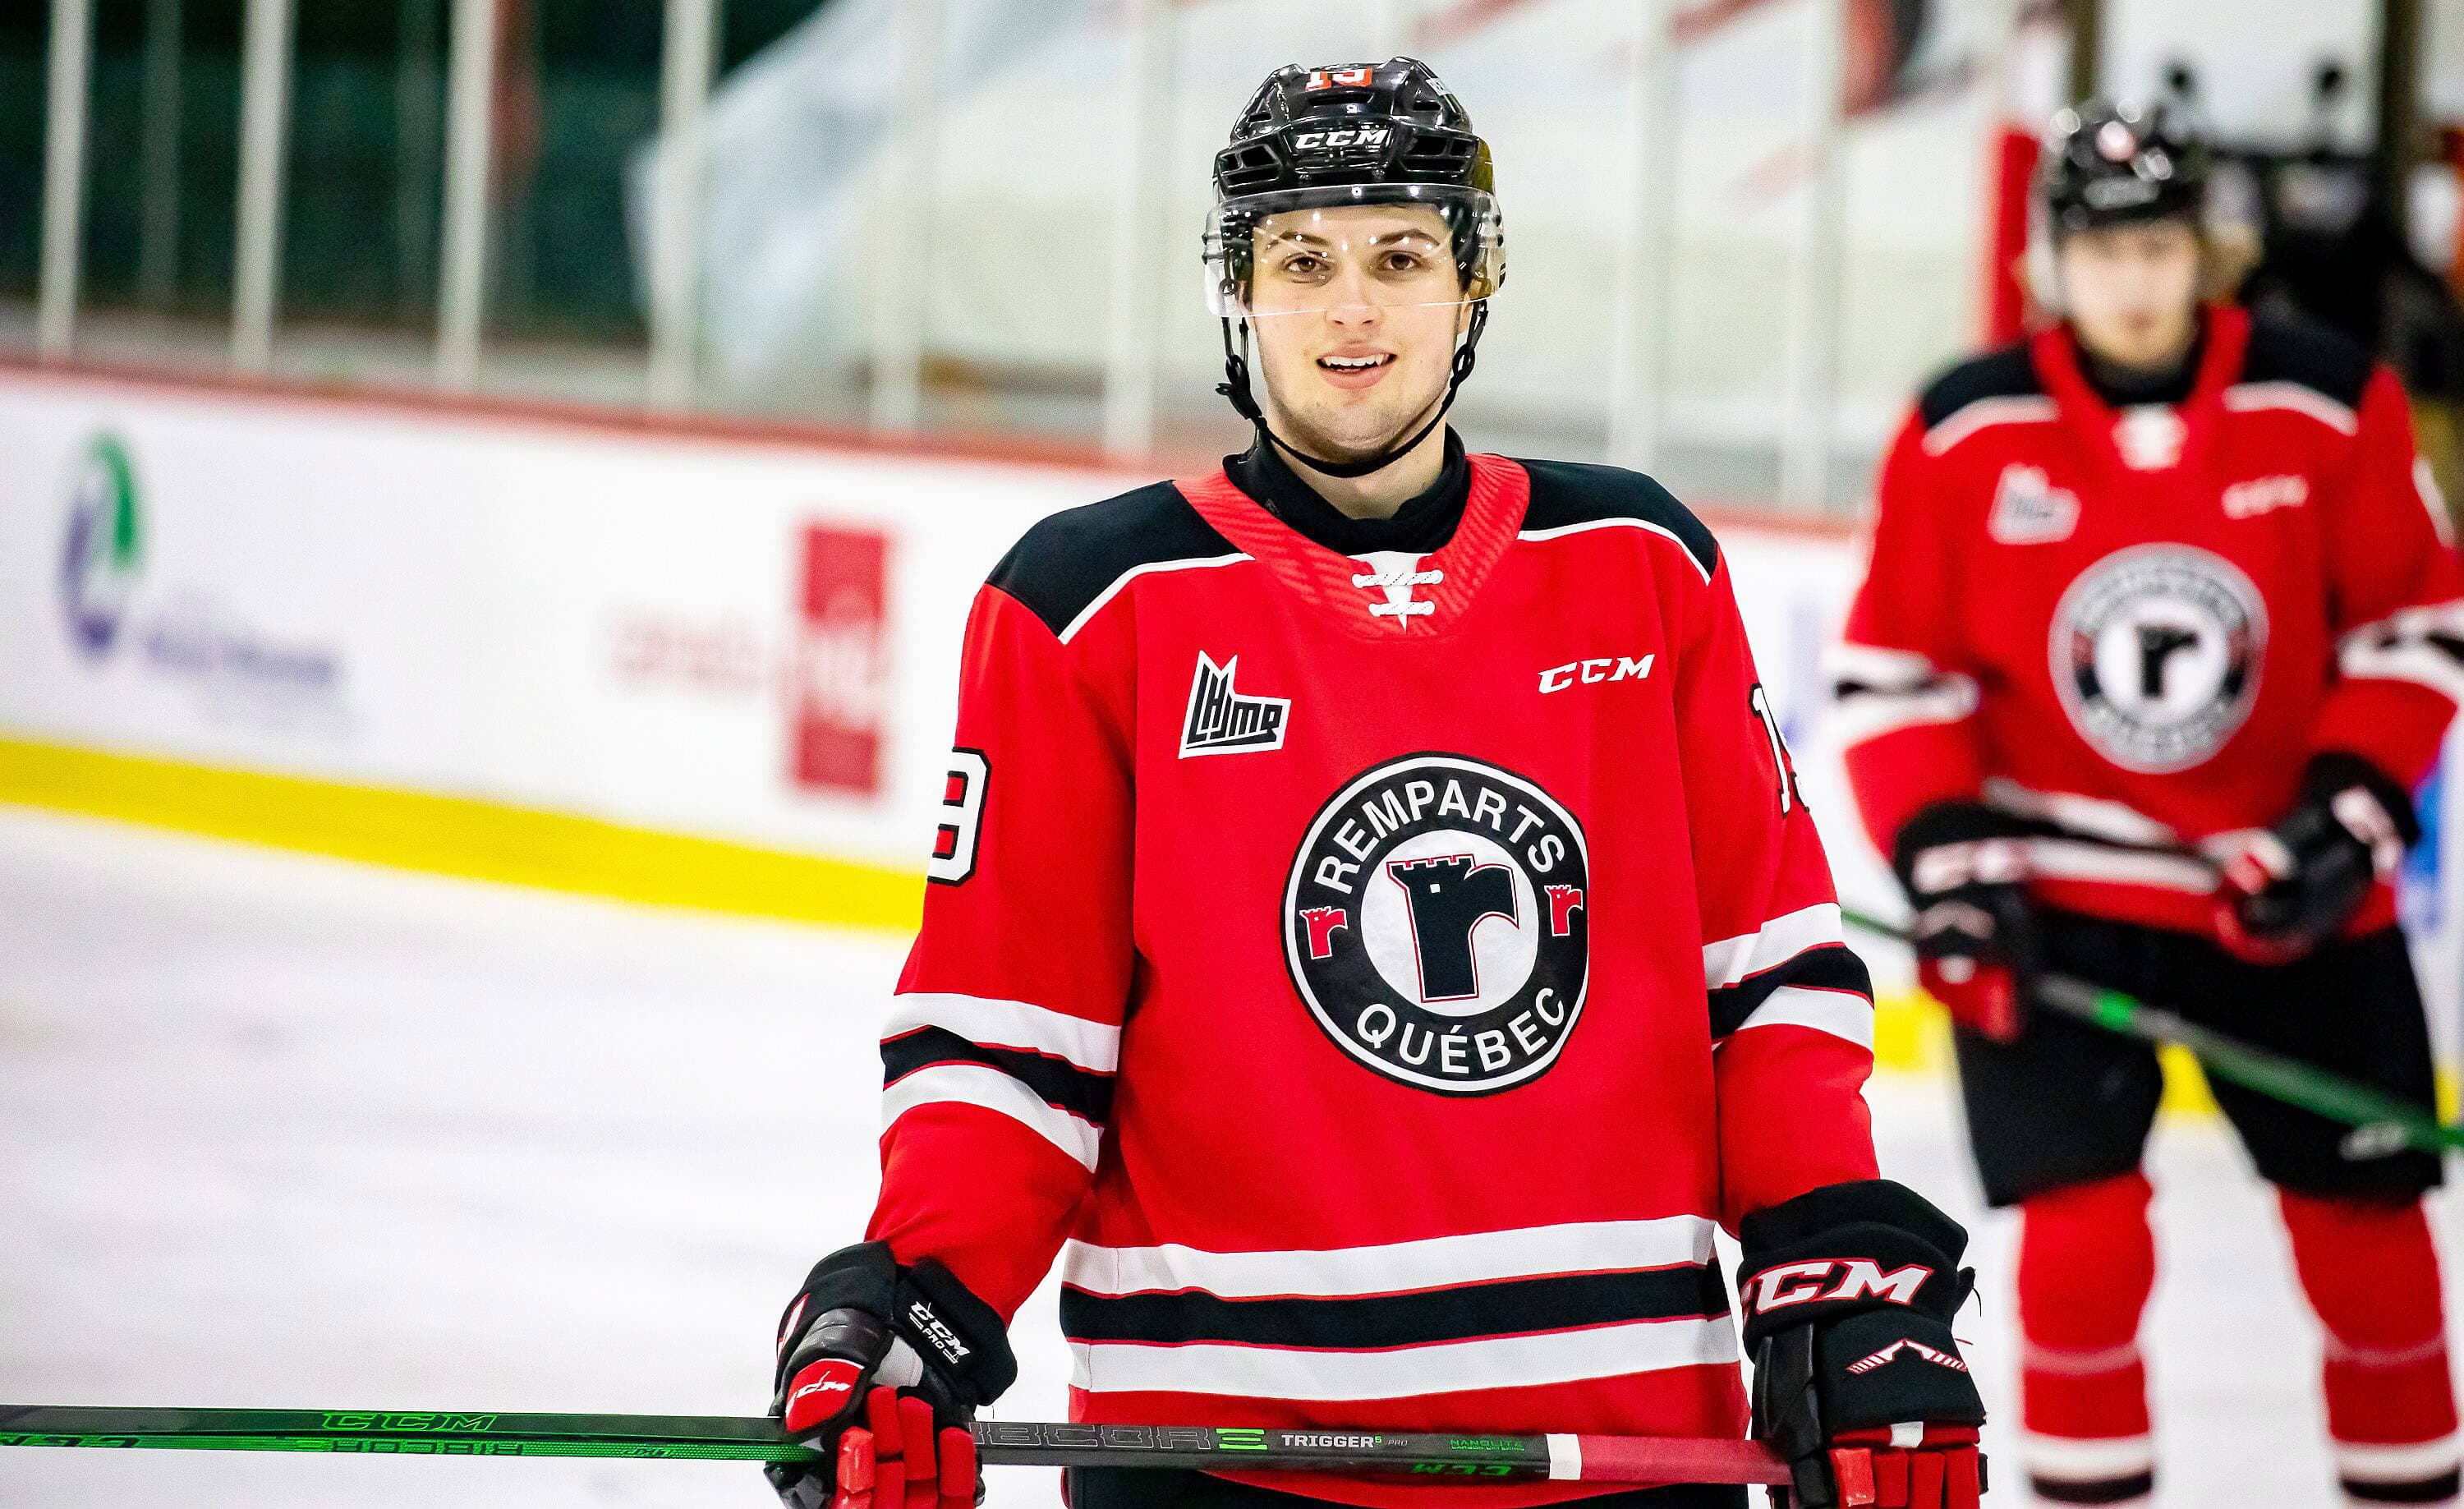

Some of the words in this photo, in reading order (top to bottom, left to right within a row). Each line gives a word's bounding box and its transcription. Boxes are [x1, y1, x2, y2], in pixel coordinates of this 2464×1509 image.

[1295, 130, 1389, 150] CCM
[1538, 654, 1656, 694] CCM
[1314, 779, 1565, 894] REMPARTS
[1357, 987, 1565, 1074] QUÉBEC
[1740, 1258, 1934, 1316] CM
[911, 1301, 971, 1357] CCM
[922, 1327, 945, 1350] PRO
[322, 1412, 498, 1432] CCM
